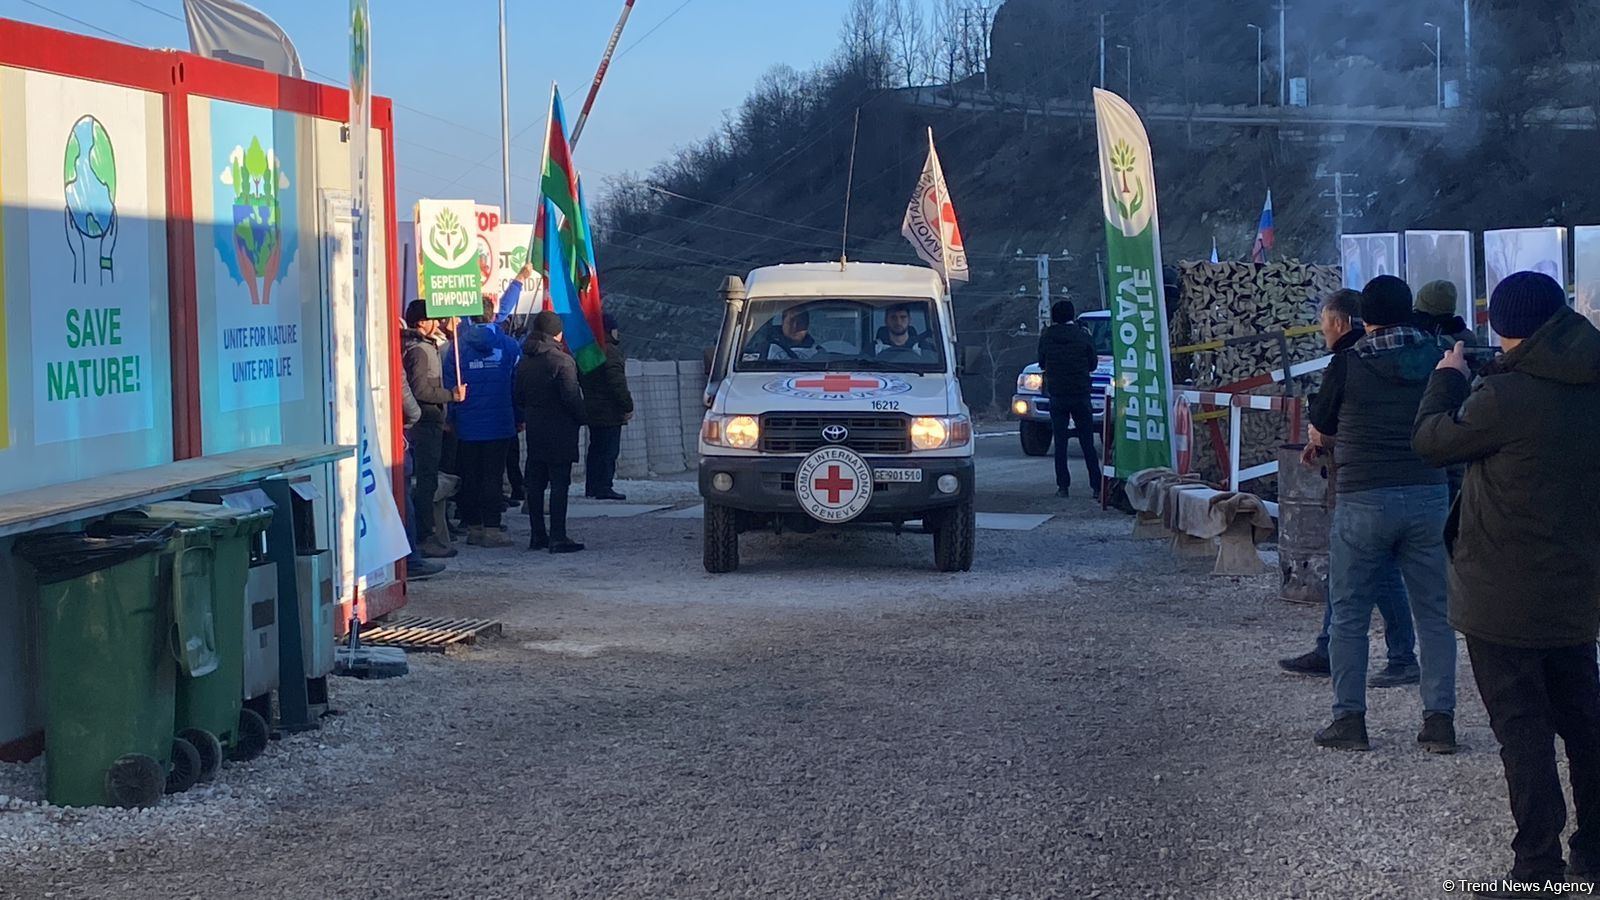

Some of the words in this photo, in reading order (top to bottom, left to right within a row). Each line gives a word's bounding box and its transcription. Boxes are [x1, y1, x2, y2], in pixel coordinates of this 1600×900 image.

[475, 211, 499, 232] OP
[430, 274, 476, 289] БЕРЕГИТЕ
[432, 291, 478, 306] ПРИРОДУ!
[66, 308, 122, 349] SAVE
[223, 327, 248, 349] UNITE
[249, 326, 267, 347] FOR
[267, 324, 297, 346] NATURE
[47, 355, 141, 402] NATURE!
[232, 360, 257, 382] UNITE
[258, 358, 274, 379] FOR
[275, 356, 292, 378] LIFE
[872, 400, 899, 410] 16212
[800, 459, 816, 500] COMITE
[815, 451, 870, 500] INTERNATIONAL
[811, 504, 857, 519] GENEVE
